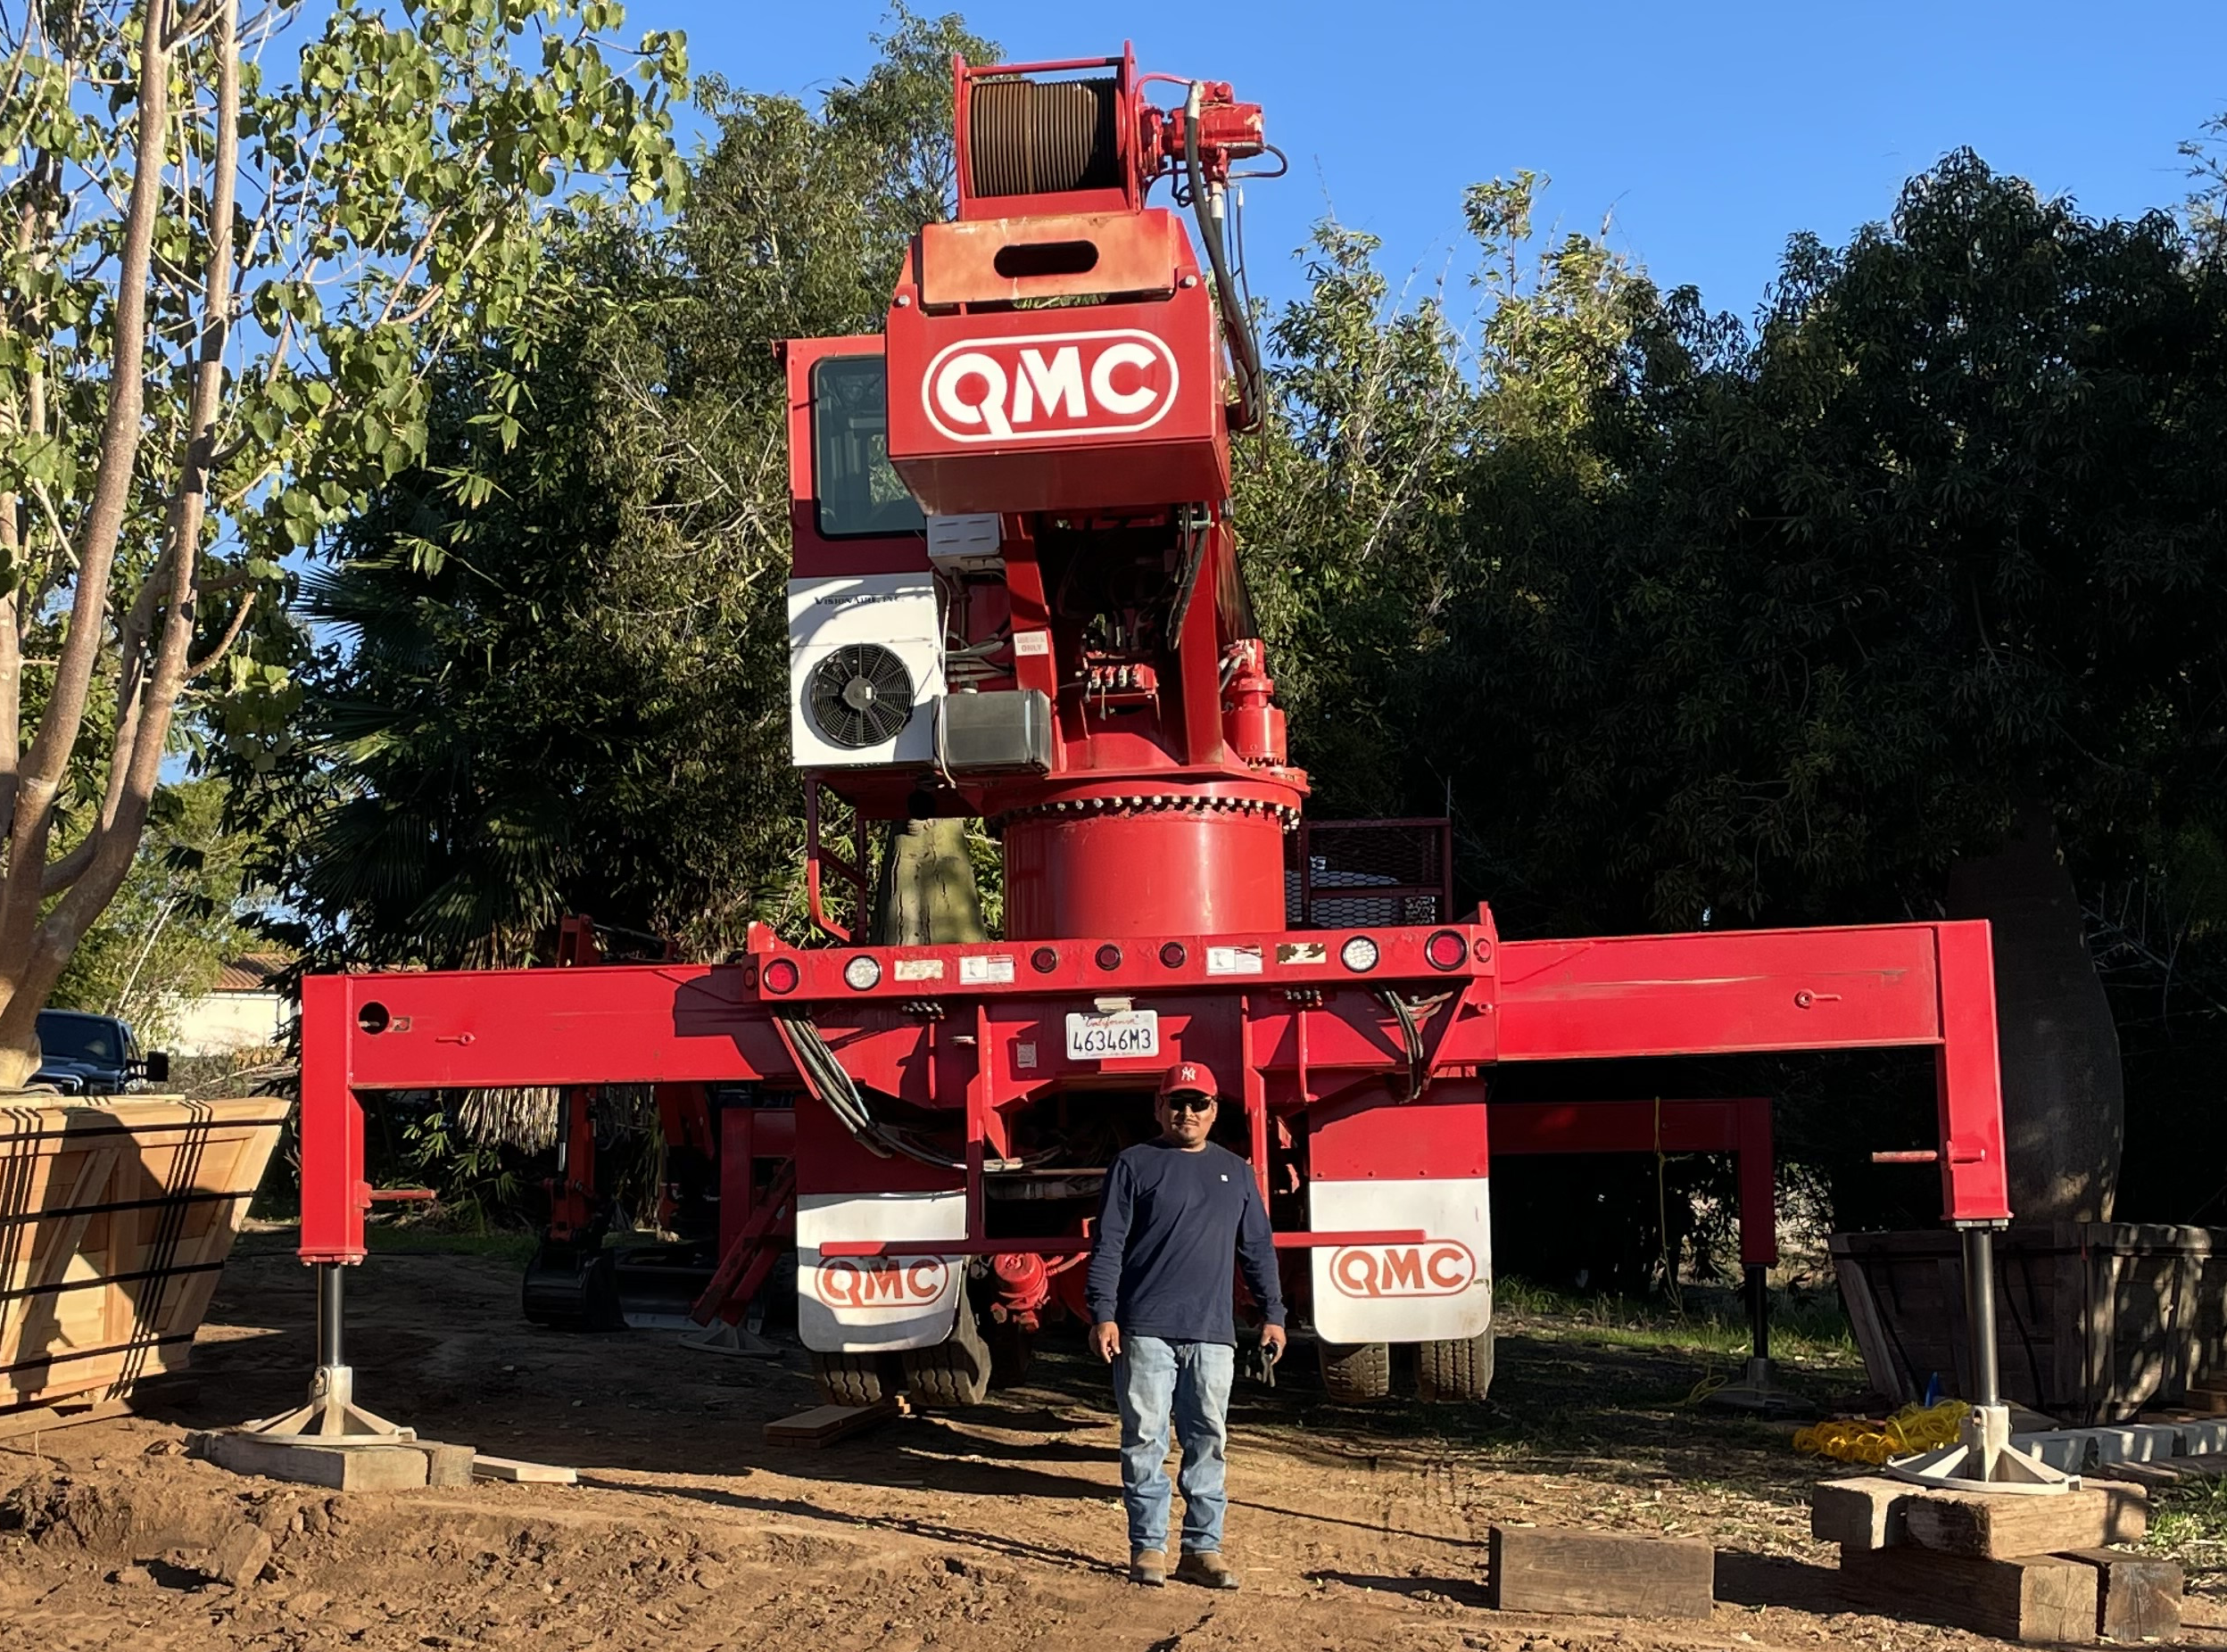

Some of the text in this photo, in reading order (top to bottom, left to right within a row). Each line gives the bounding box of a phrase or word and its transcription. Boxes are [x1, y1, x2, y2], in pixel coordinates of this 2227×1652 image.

[936, 343, 1158, 435] QMC
[1073, 1028, 1151, 1052] 46346M3
[1086, 1018, 1138, 1028] California
[822, 1259, 940, 1307] QMC
[1337, 1247, 1465, 1296] QMC
